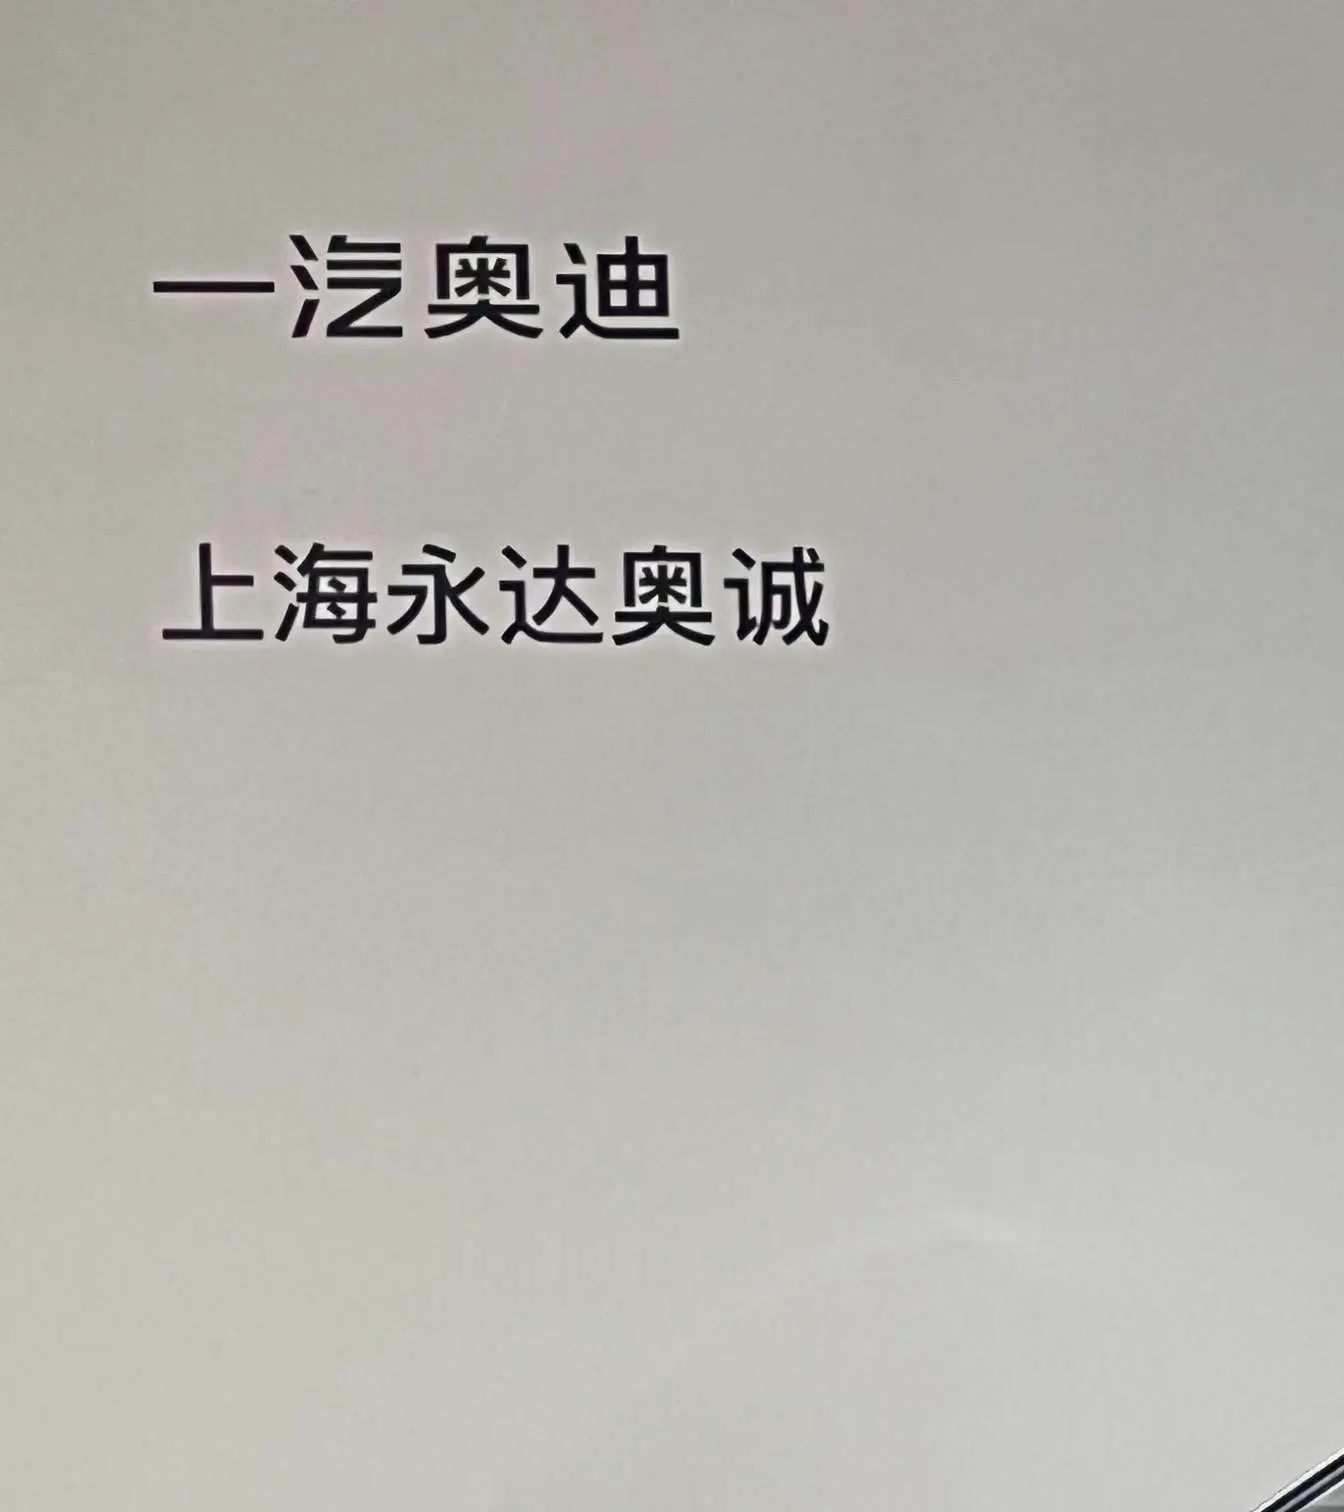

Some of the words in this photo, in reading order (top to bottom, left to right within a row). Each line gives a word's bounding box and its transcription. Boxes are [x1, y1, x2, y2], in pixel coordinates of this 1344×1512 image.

[153, 235, 679, 339] 一汽奥迪
[163, 543, 828, 646] 上海永达奥诚
